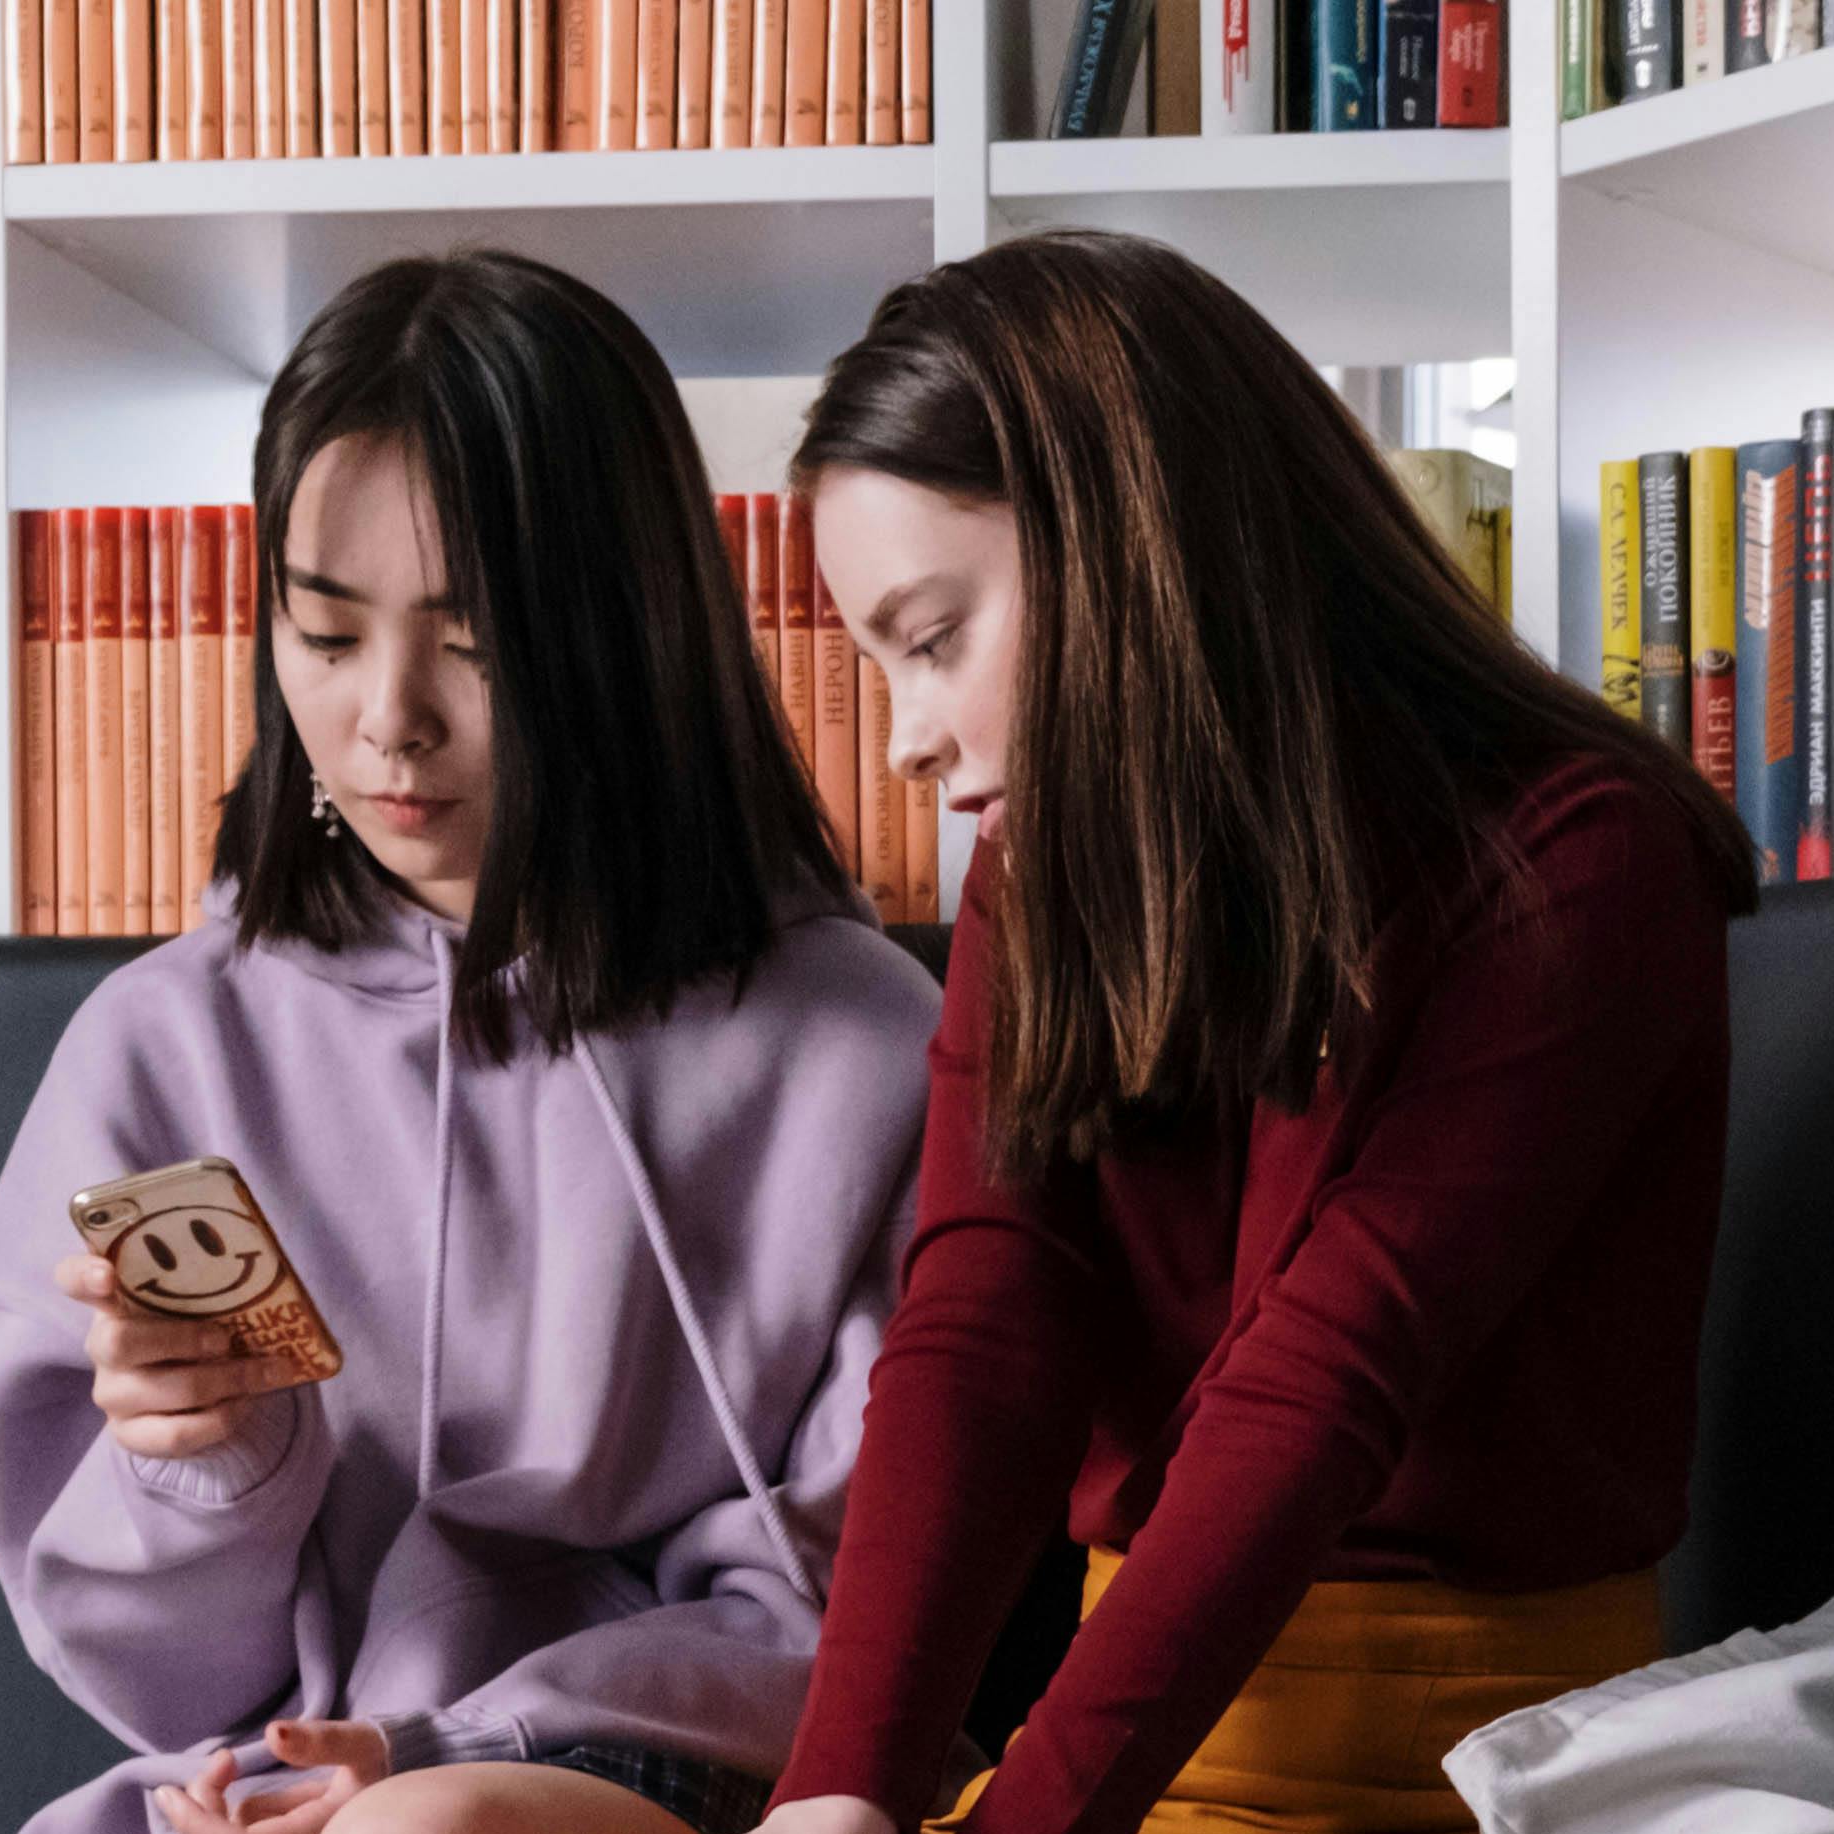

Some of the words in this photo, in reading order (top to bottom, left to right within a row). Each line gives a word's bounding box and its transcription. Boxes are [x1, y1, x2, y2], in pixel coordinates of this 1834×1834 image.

[1657, 474, 1679, 623] ПОКОЙНИК
[1803, 454, 1831, 582] ЦЕПЬ
[787, 633, 806, 709] НАВИН
[824, 633, 845, 724] НЕРОН
[1809, 598, 1826, 714] МАККИНТИ
[1808, 721, 1827, 806] ЭДРИАН
